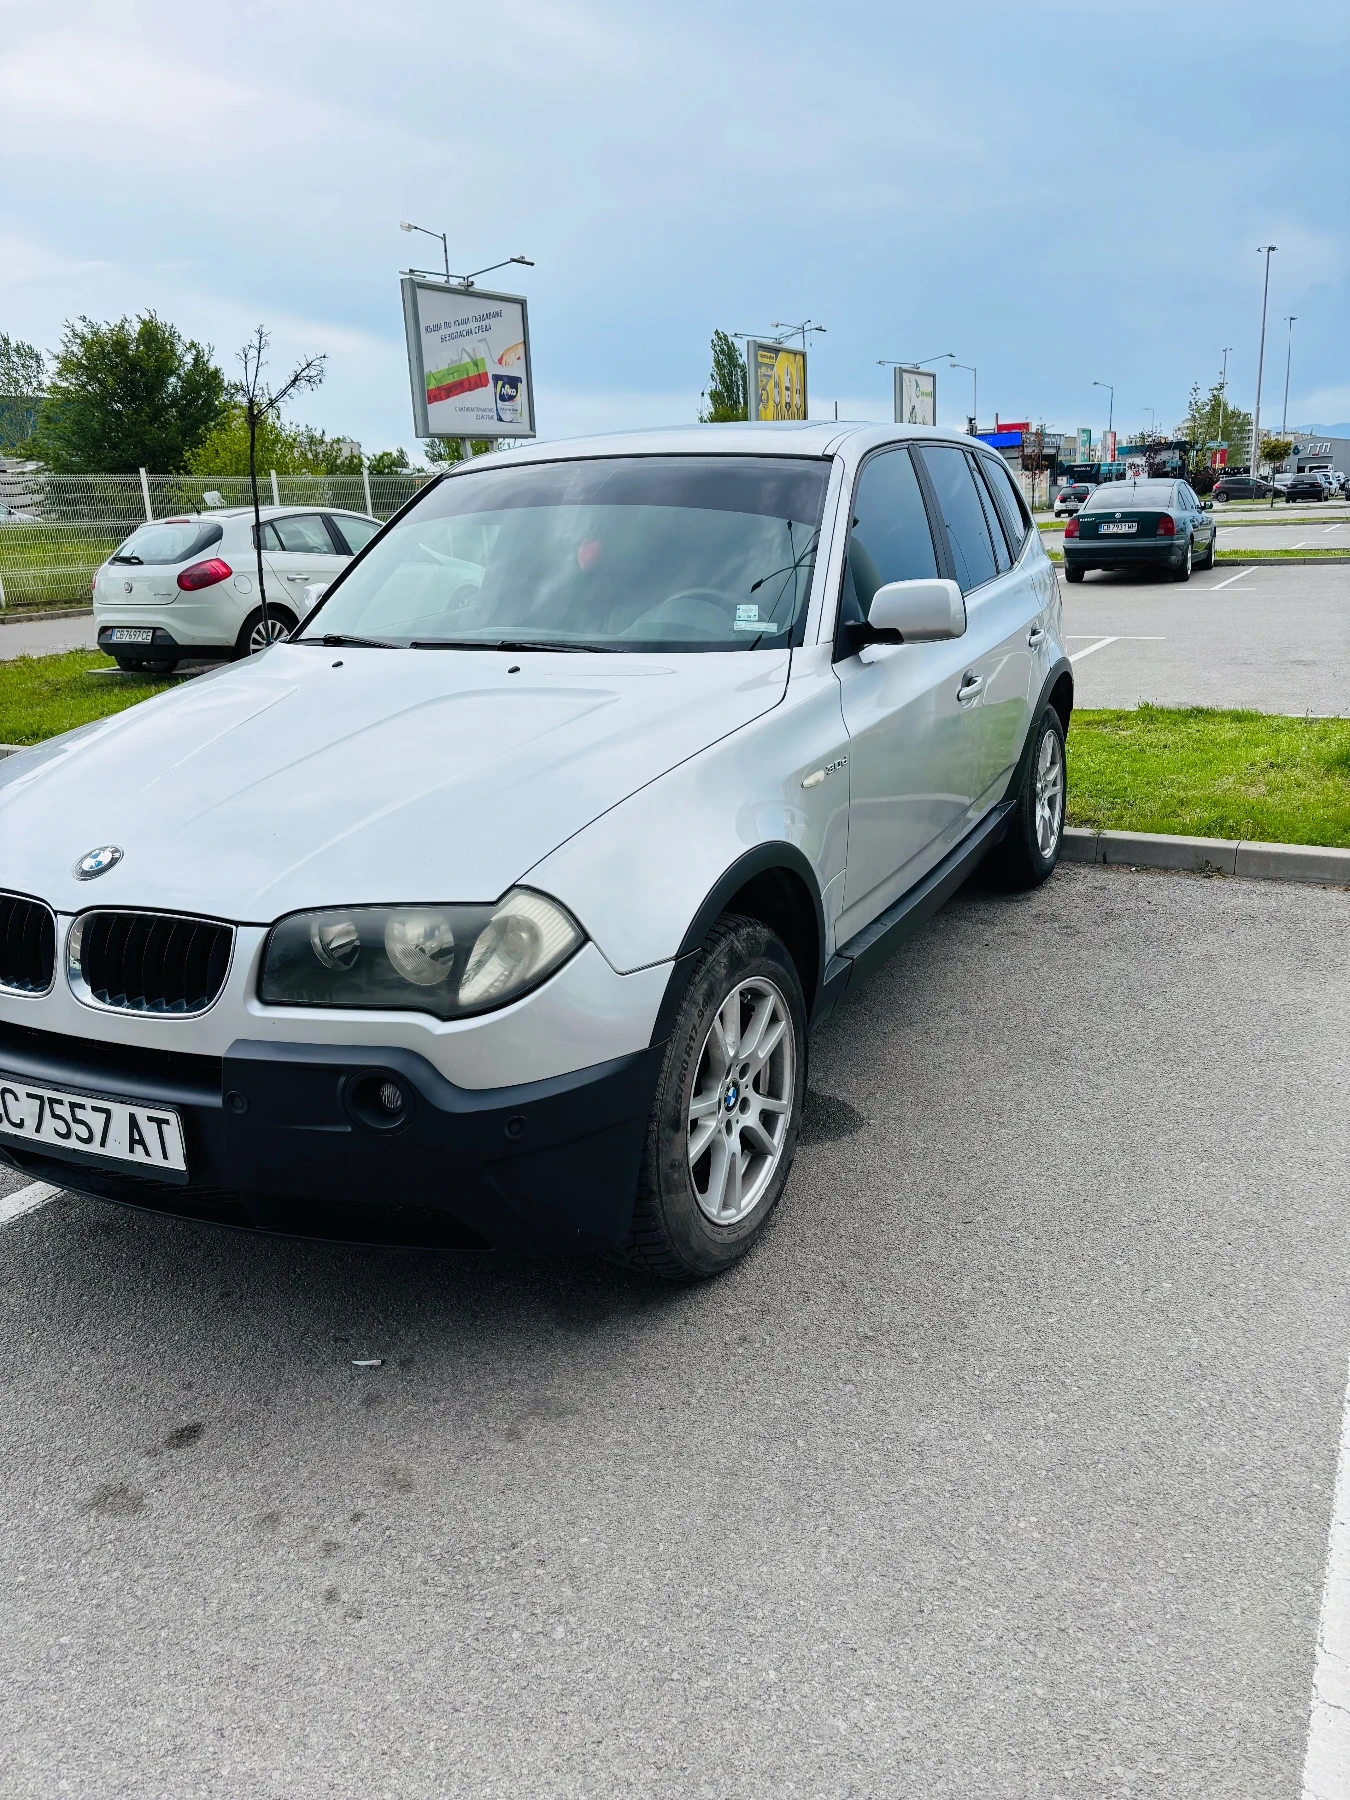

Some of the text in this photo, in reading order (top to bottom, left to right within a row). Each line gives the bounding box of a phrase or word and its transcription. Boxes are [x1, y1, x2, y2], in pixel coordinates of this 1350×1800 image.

[440, 323, 492, 343] БЕЗОПАСНА СРЕДА
[1306, 442, 1332, 454] ГТП
[0, 1086, 112, 1149] C7557
